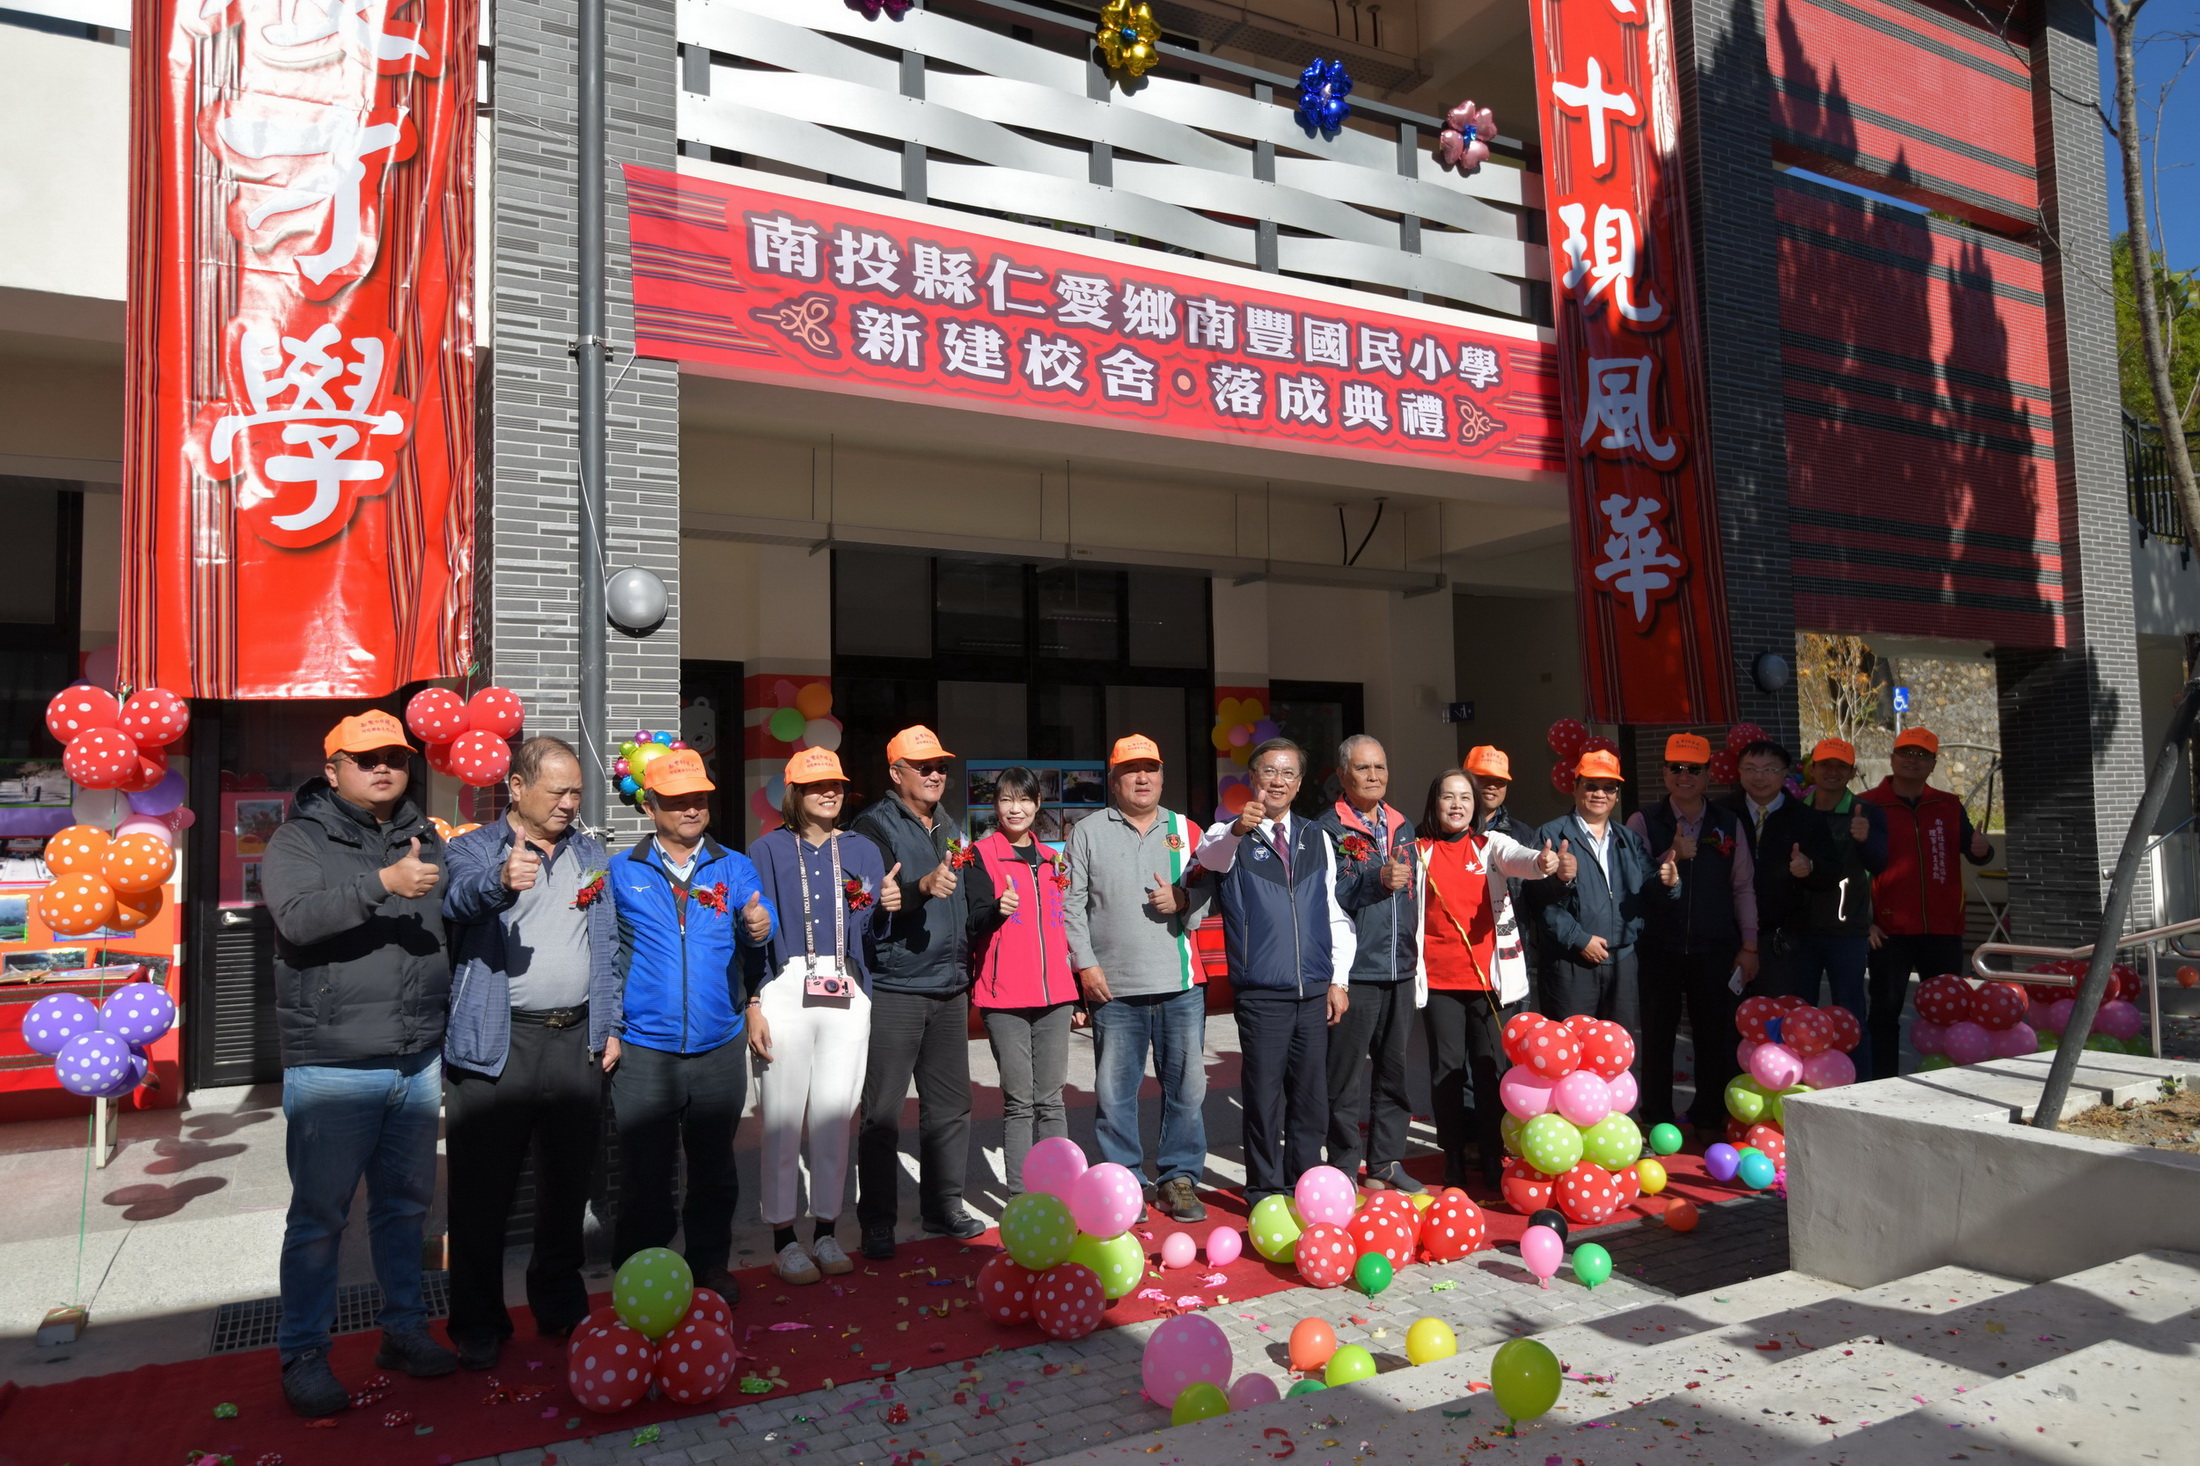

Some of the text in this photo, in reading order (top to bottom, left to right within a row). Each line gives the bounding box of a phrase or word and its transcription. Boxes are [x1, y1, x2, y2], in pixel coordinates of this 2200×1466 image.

[748, 214, 1502, 389] 南投縣仁愛鄉南豐國民小學
[1551, 0, 1681, 623] 十現風華
